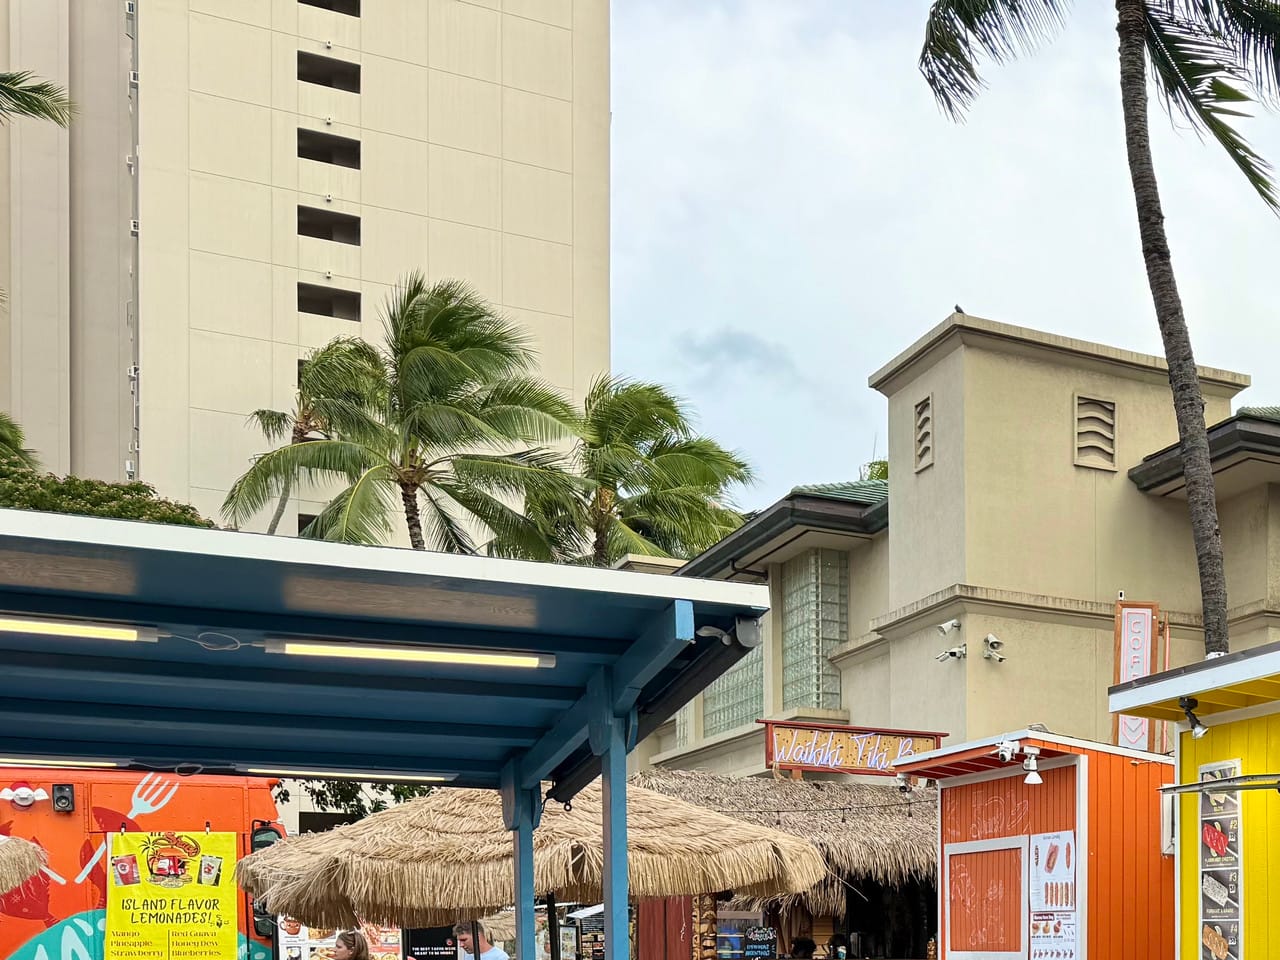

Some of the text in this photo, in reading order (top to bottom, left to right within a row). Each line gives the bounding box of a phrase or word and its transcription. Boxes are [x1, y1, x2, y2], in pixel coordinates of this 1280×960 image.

[773, 729, 890, 770] Waikiki Tiki
[121, 898, 219, 910] ISLAND FLAVOR
[131, 912, 212, 924] LEMONADES!
